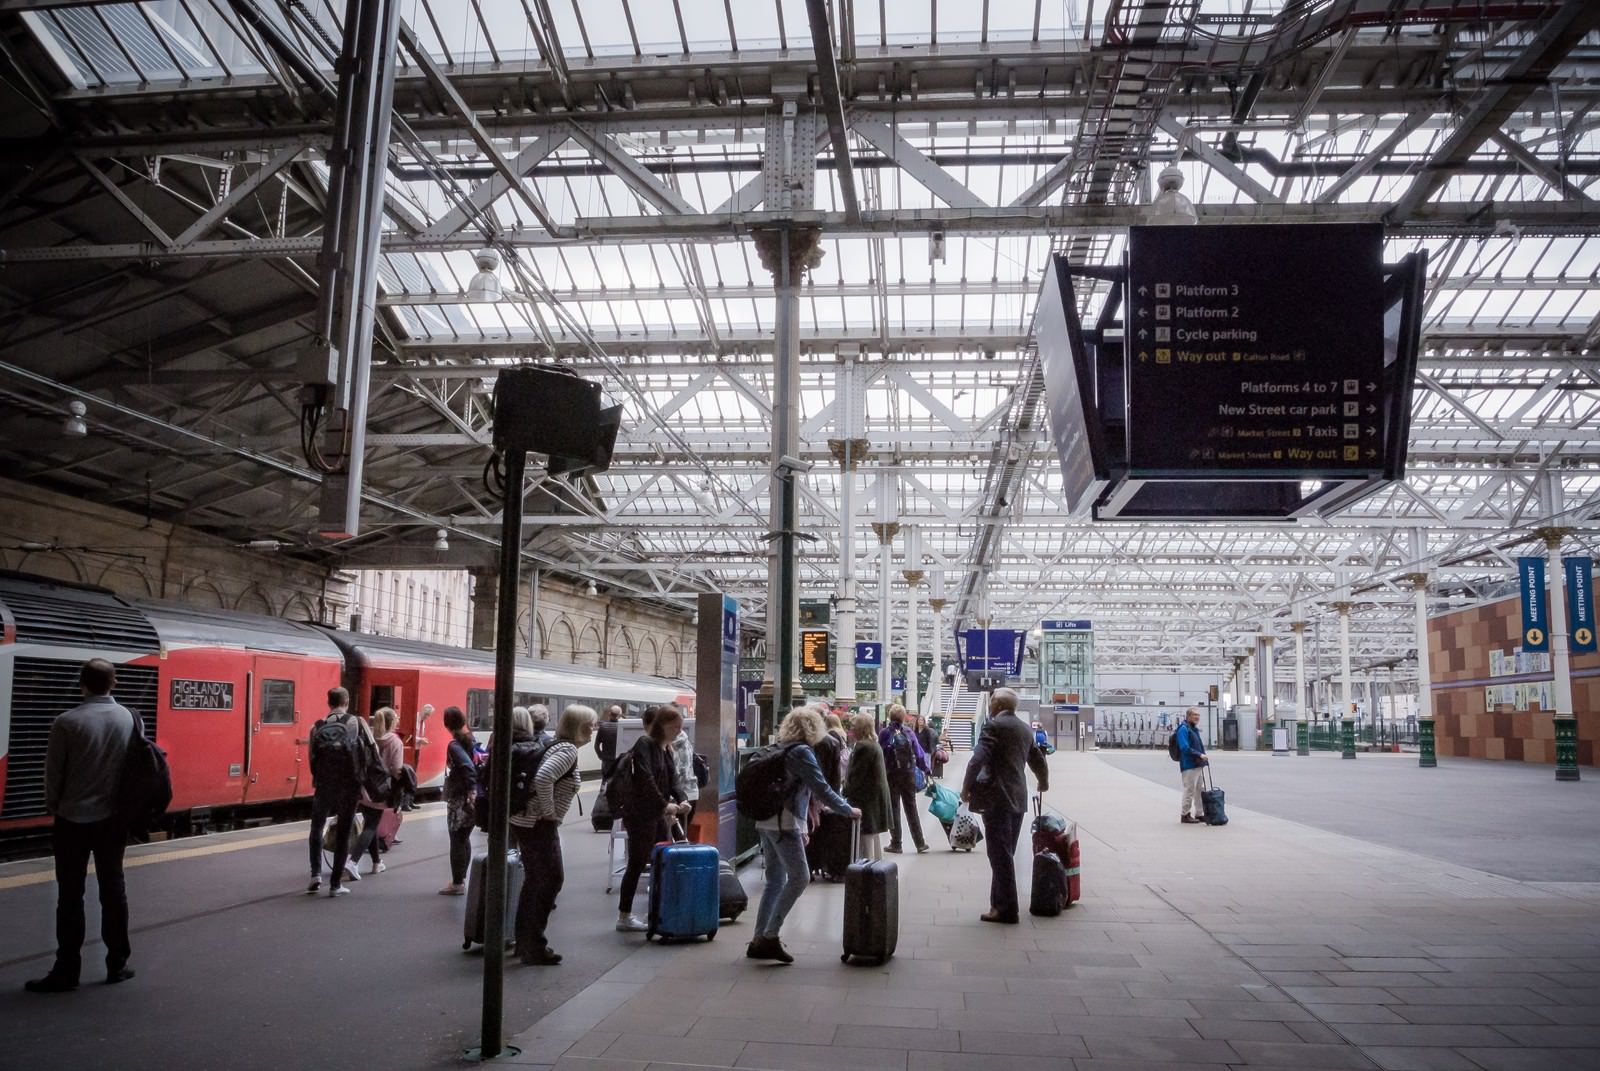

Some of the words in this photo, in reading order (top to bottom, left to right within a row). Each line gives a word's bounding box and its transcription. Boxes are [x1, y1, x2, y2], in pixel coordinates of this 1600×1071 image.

[1176, 285, 1228, 296] Platform
[1231, 285, 1239, 296] 3
[1176, 306, 1228, 318] Platform
[1231, 307, 1239, 318] 2
[1176, 328, 1209, 342] Cycle
[1212, 328, 1257, 342] parking
[1177, 351, 1201, 363] Way
[1205, 352, 1227, 361] out
[1240, 382, 1299, 393] Platforms
[1302, 382, 1310, 393] 4
[1314, 383, 1327, 393] to
[1329, 382, 1338, 393] 7
[1218, 404, 1245, 415] New
[1248, 404, 1286, 415] Street
[1289, 406, 1307, 415] car
[1311, 404, 1337, 416] park
[1307, 425, 1338, 437] Taxis
[1288, 448, 1313, 461] Way
[1316, 449, 1337, 459] out
[1528, 565, 1536, 588] POINT
[1575, 565, 1583, 588] POINT
[1529, 589, 1538, 622] MEETING
[1577, 588, 1586, 622] MEETING
[864, 646, 874, 660] 2
[173, 681, 221, 696] HIGHLAND
[895, 680, 901, 688] 2
[173, 693, 219, 708] CHIEFTAIN
